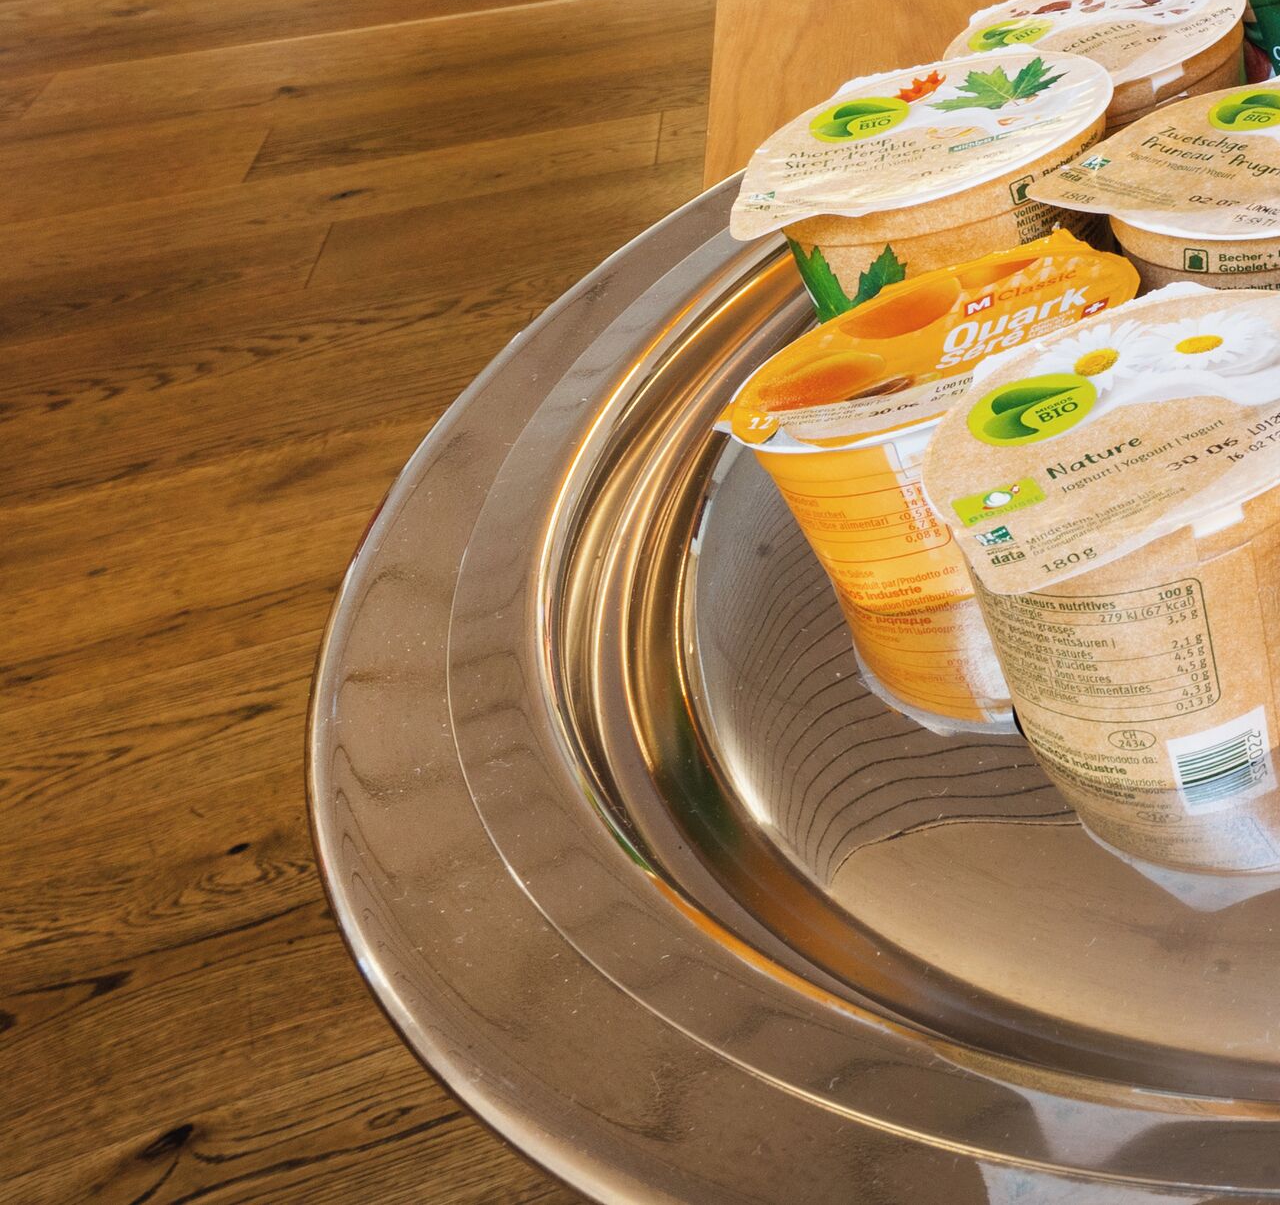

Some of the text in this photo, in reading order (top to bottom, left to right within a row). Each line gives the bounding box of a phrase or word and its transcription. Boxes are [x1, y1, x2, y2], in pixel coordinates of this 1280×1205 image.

[1014, 25, 1042, 43] BIO
[859, 118, 892, 131] BIO
[1243, 113, 1271, 124] BIO
[1159, 126, 1249, 152] Zwetschge
[1141, 137, 1212, 163] Pruneau
[1218, 251, 1263, 263] Becher
[1218, 262, 1269, 274] Gobelet
[966, 269, 1077, 317] M Classic
[942, 285, 1089, 354] Quark
[1034, 397, 1074, 414] MIGROS
[1038, 402, 1079, 423] BIO
[748, 415, 773, 430] 12
[1045, 436, 1143, 480] Nature
[1061, 419, 1225, 495] Joghurt Yogourt Yogurt
[839, 517, 889, 531] alimentari
[991, 549, 1027, 566] data
[1018, 588, 1181, 612] valeurs nutritives 100
[1165, 596, 1195, 612] kcal)
[1037, 621, 1076, 637] grasses
[1053, 635, 1109, 649] Fettsäuren
[1055, 646, 1094, 661] saturés
[1055, 658, 1098, 673] glucides
[1078, 673, 1112, 685] sucres
[1054, 679, 1153, 696] fibres alimentaires
[1119, 738, 1146, 748] 2434
[1072, 757, 1127, 775] Industrie
